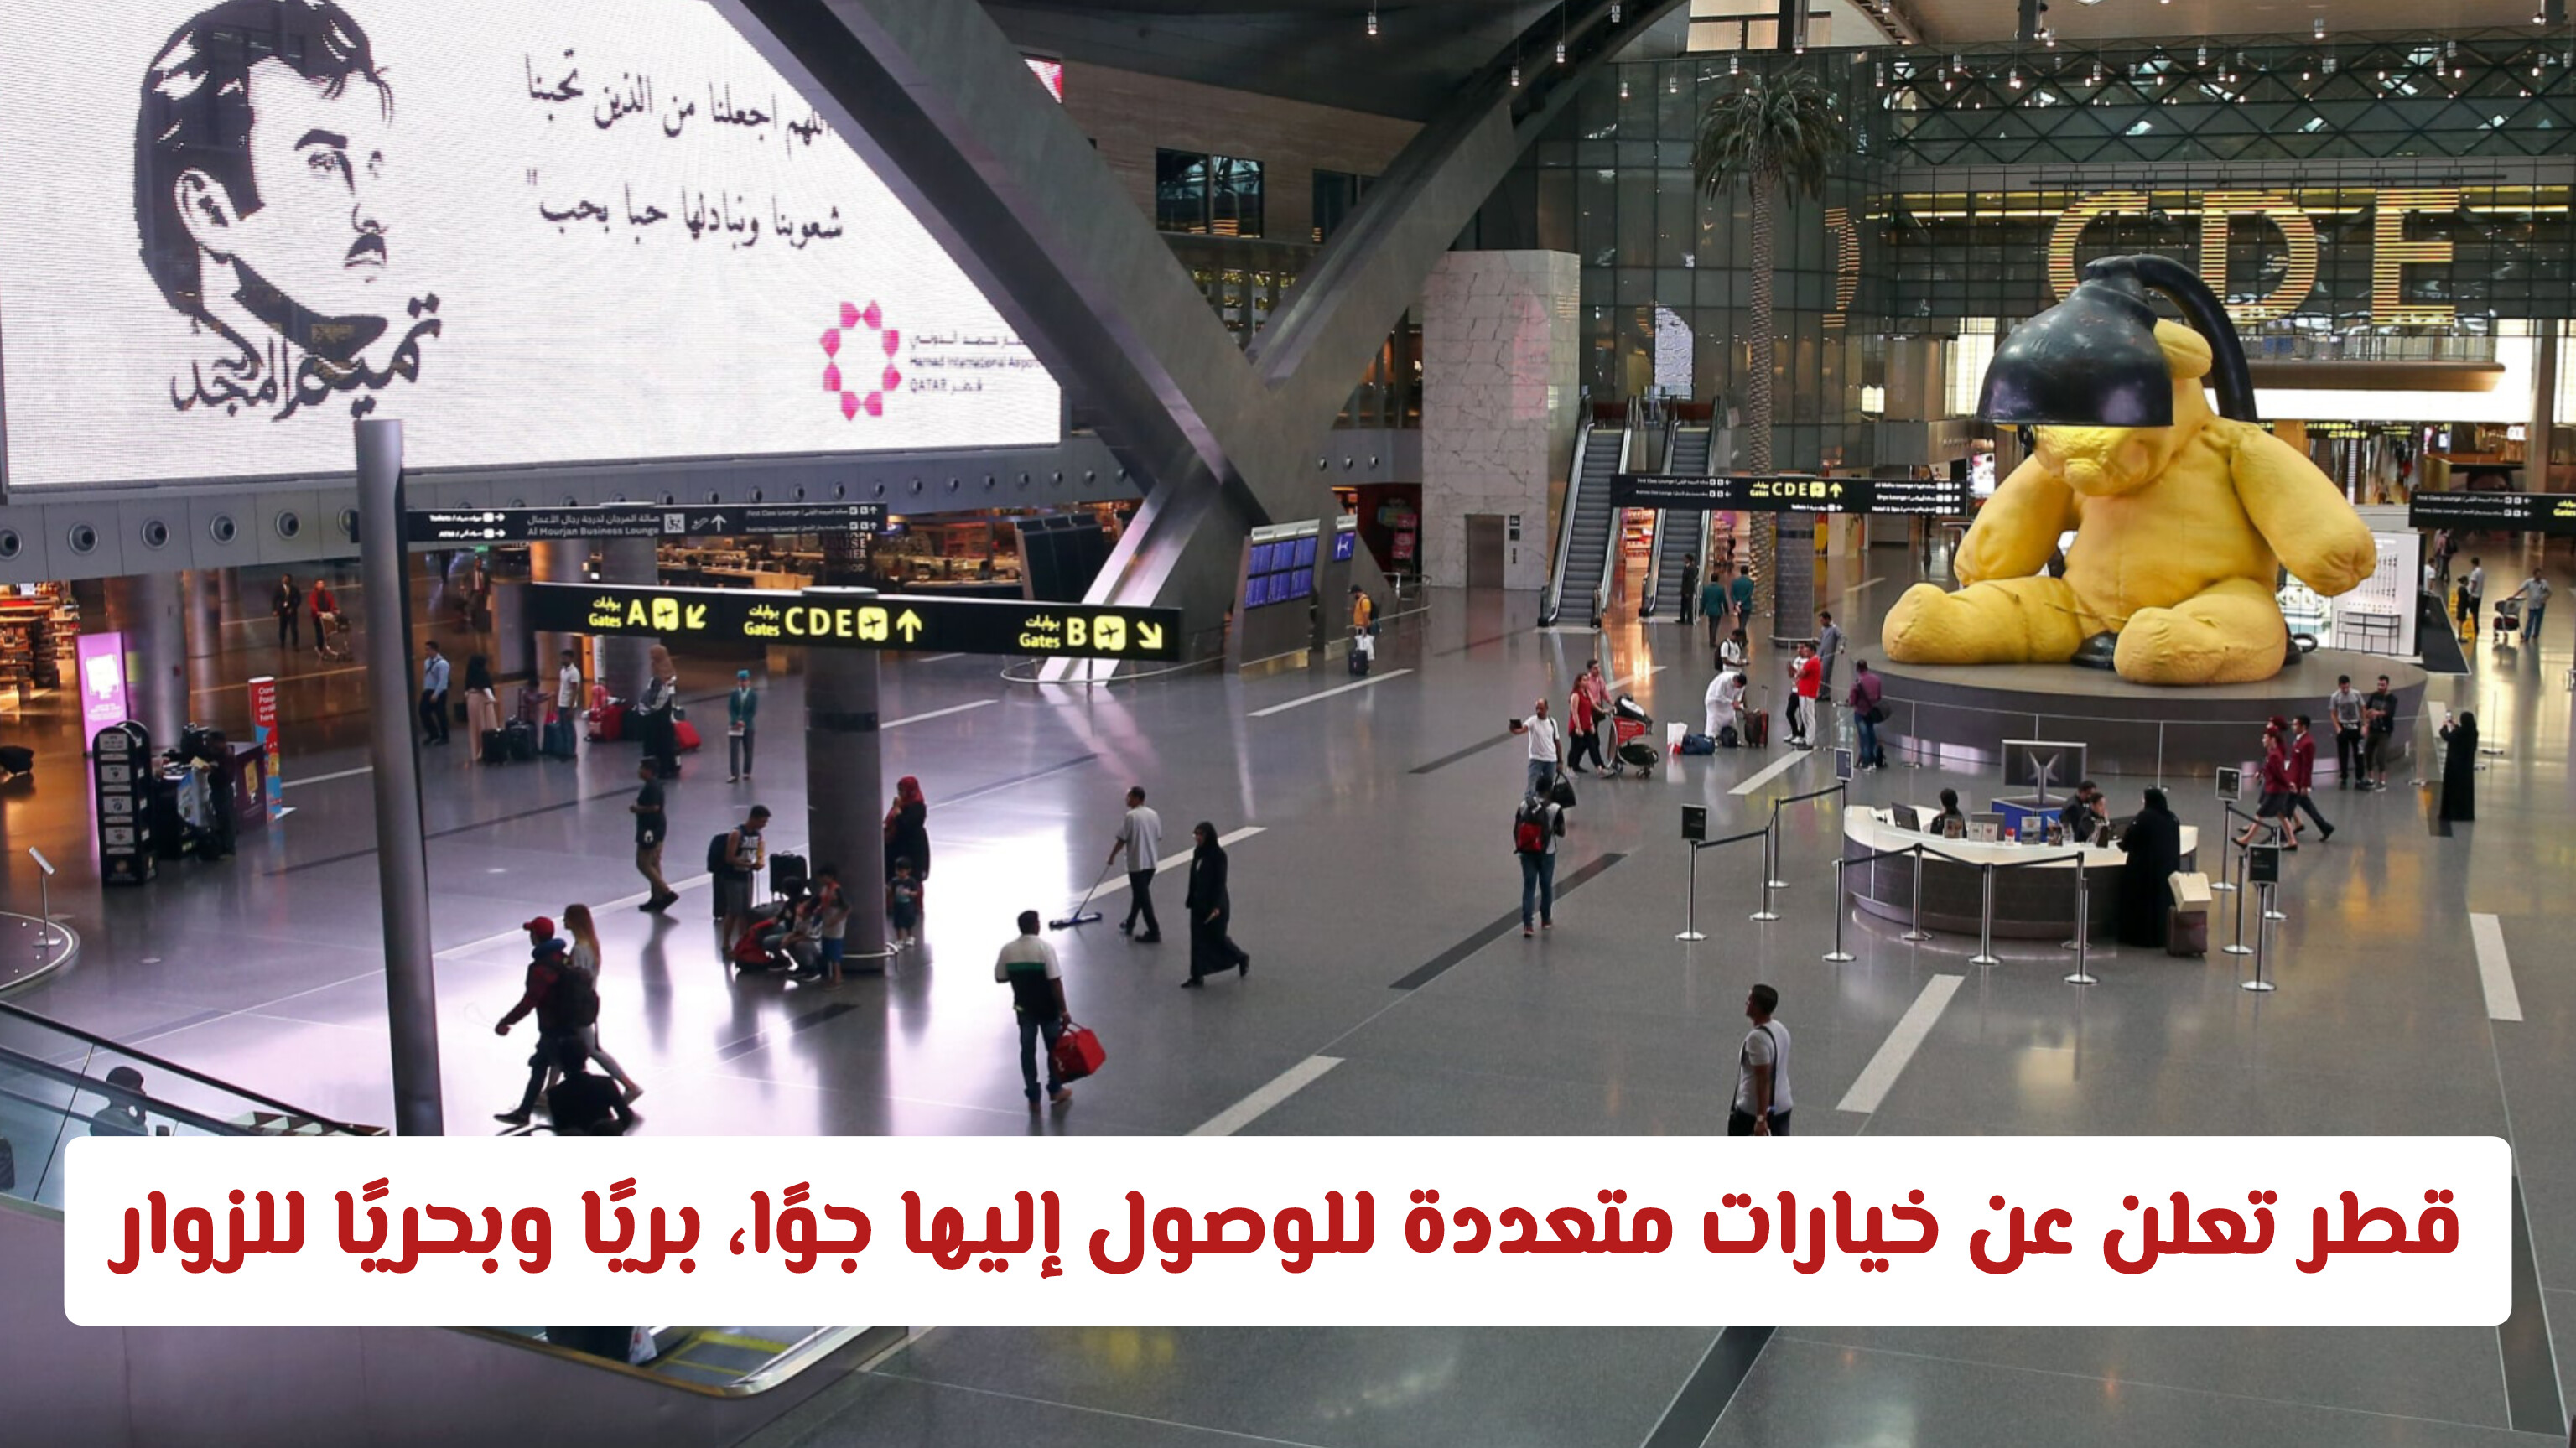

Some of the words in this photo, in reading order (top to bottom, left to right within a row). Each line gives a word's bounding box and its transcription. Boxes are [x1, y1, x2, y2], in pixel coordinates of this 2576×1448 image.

[594, 72, 652, 129] الذين
[663, 96, 695, 138] من
[709, 81, 777, 142] اجعلنا
[787, 108, 830, 159] لهم
[625, 182, 668, 244] حبا
[682, 186, 759, 250] ونبادلها
[772, 195, 842, 250] شعوبنا
[911, 378, 947, 393] QATAR
[539, 527, 578, 537] Mourjan
[580, 527, 623, 536] Business
[625, 527, 660, 537] Lounge
[589, 614, 621, 628] Gates
[627, 599, 647, 626] A
[744, 621, 780, 637] Gates
[1019, 633, 1061, 649] Gates
[1067, 617, 1087, 646] B
